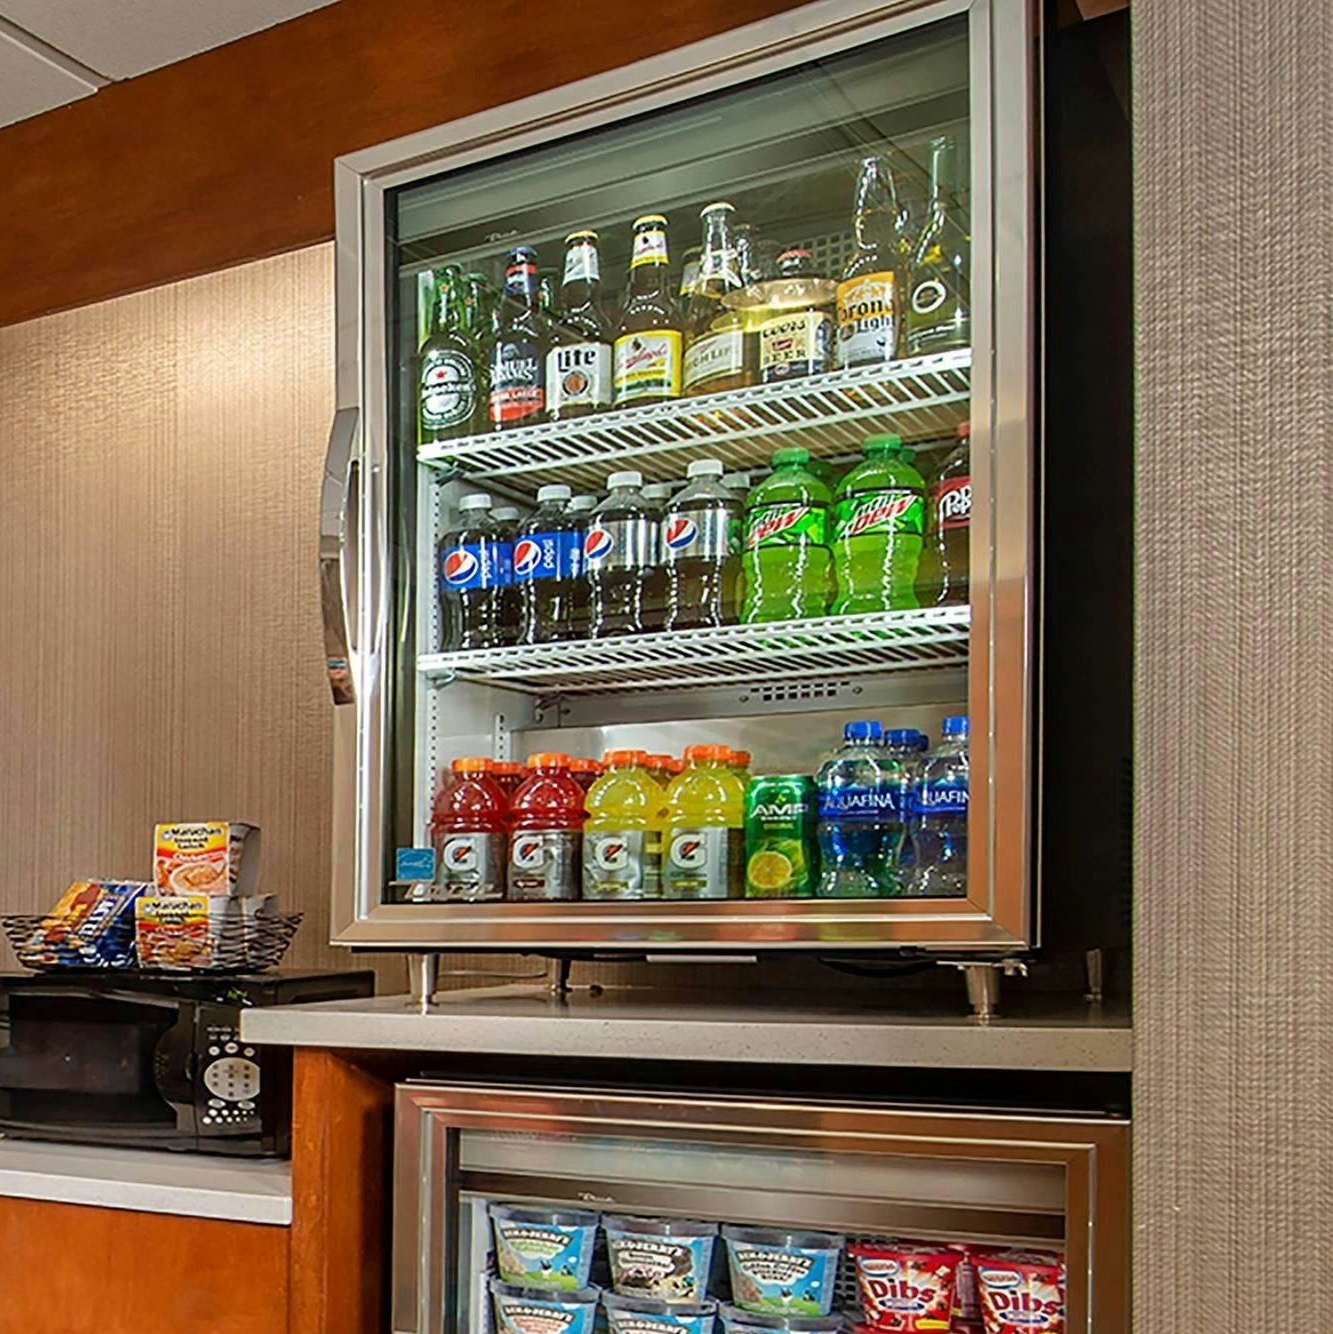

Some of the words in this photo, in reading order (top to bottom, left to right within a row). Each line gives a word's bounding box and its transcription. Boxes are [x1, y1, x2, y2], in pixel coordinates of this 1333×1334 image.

[557, 349, 595, 373] Lite
[824, 793, 895, 811] AQUAFINA
[444, 838, 478, 871] G
[513, 835, 544, 868] G
[595, 836, 629, 870] G
[670, 833, 708, 868] G
[868, 1278, 936, 1303] Dibs
[988, 1290, 1063, 1315] Dibs
